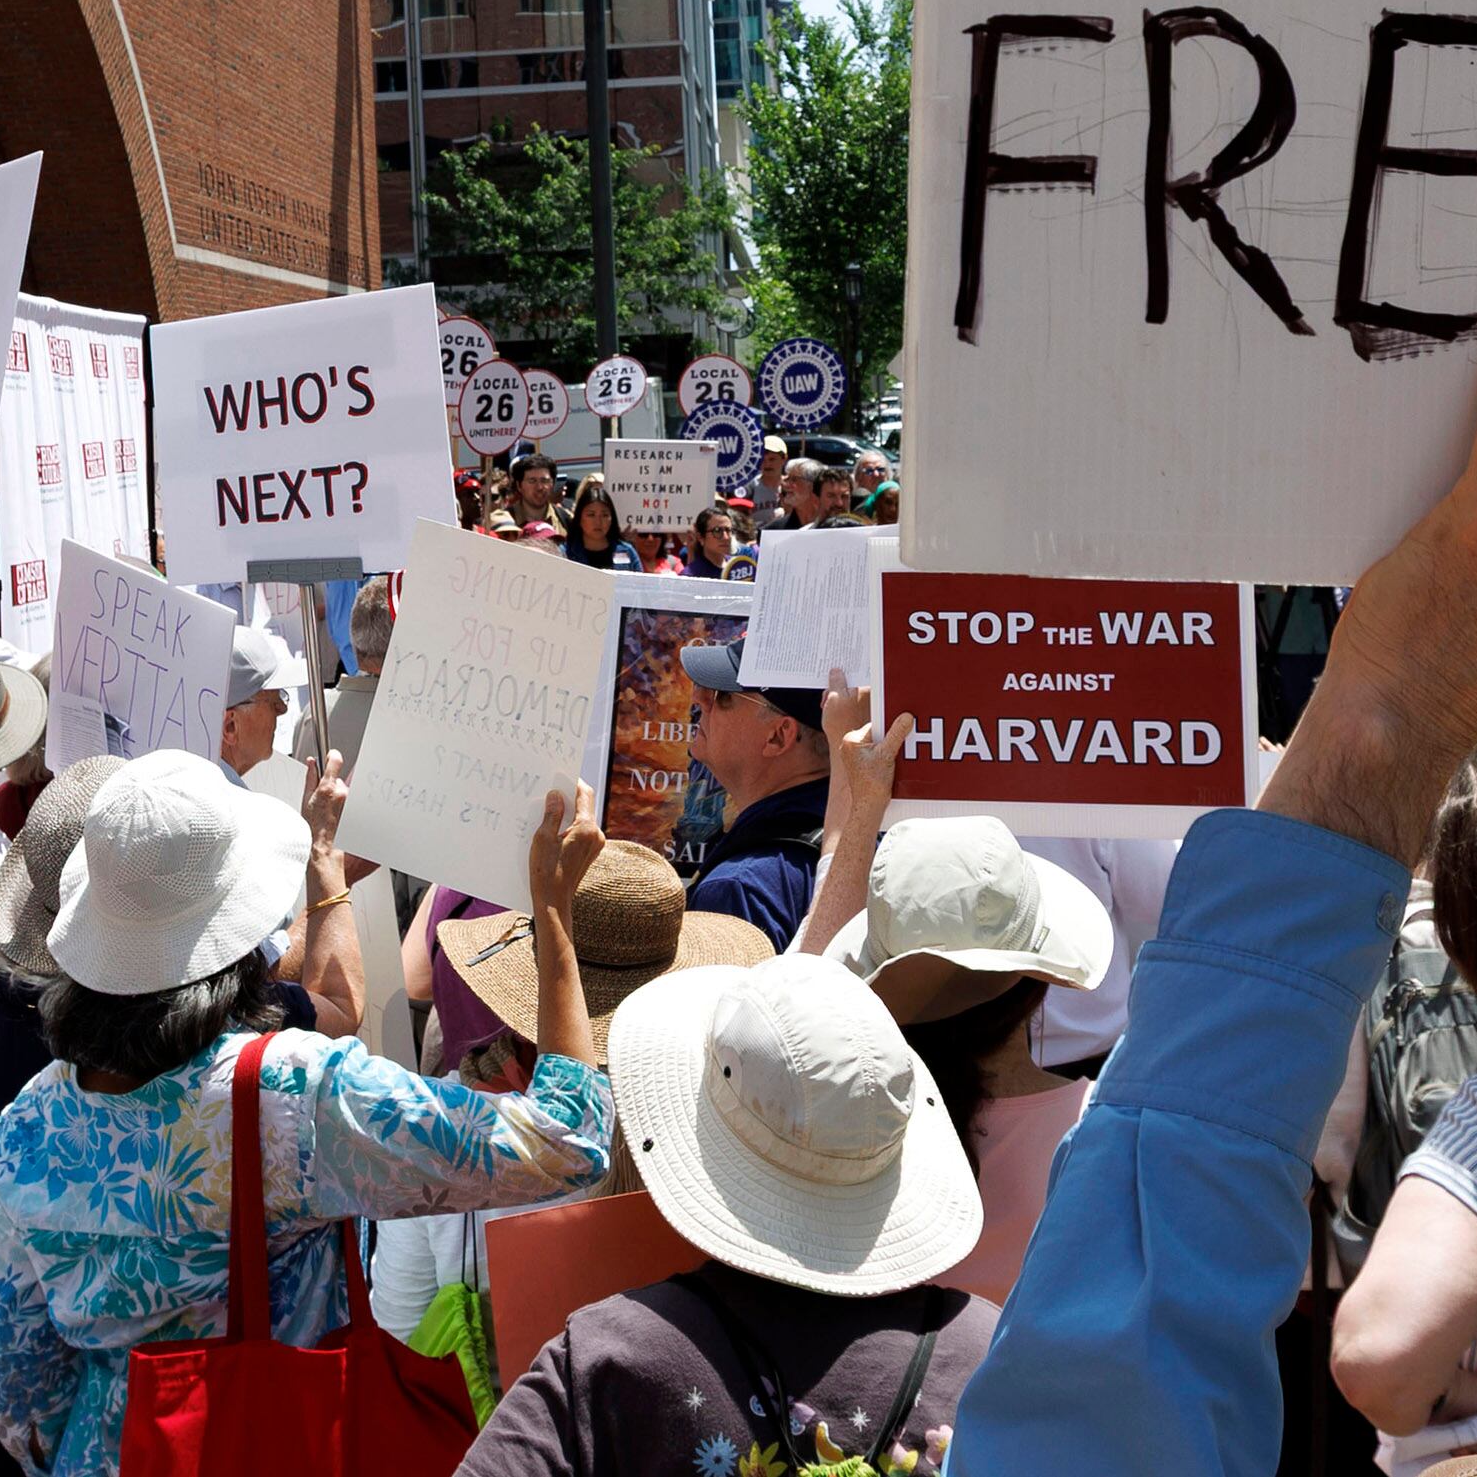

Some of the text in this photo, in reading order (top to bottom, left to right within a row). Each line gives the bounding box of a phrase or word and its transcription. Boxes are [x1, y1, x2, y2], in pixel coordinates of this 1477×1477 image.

[198, 162, 237, 206] JOHN
[242, 179, 287, 221] JOSEPH
[200, 207, 254, 252] UNITED
[259, 225, 300, 265] STATES
[440, 333, 485, 348] OCAL
[441, 348, 480, 377] 26
[595, 366, 636, 378] LOCAL
[473, 378, 519, 391] LOCAL
[690, 369, 739, 379] LOCAL
[784, 373, 819, 394] UAW
[530, 382, 556, 392] CAL
[598, 377, 632, 398] 26
[695, 380, 736, 404] 26
[203, 365, 376, 434] WHO'S
[475, 393, 514, 423] 26
[469, 427, 517, 438] UNITEHERE!
[614, 449, 684, 462] RESEARCH
[706, 436, 739, 454] AW
[639, 465, 673, 475] IS AN
[215, 461, 369, 527] NEXT?
[611, 482, 692, 495] INVESTMENT
[642, 499, 669, 509] NOT
[626, 514, 694, 525] CHARITY
[730, 564, 754, 580] 32BJ
[91, 569, 191, 658] SPEAK
[906, 610, 1216, 647] STOP THE WAR
[58, 612, 220, 760] VERITAS
[1002, 671, 1116, 693] AGAINST
[641, 720, 701, 743] LIBE
[902, 717, 1224, 767] HARVARD
[627, 767, 690, 794] NOT
